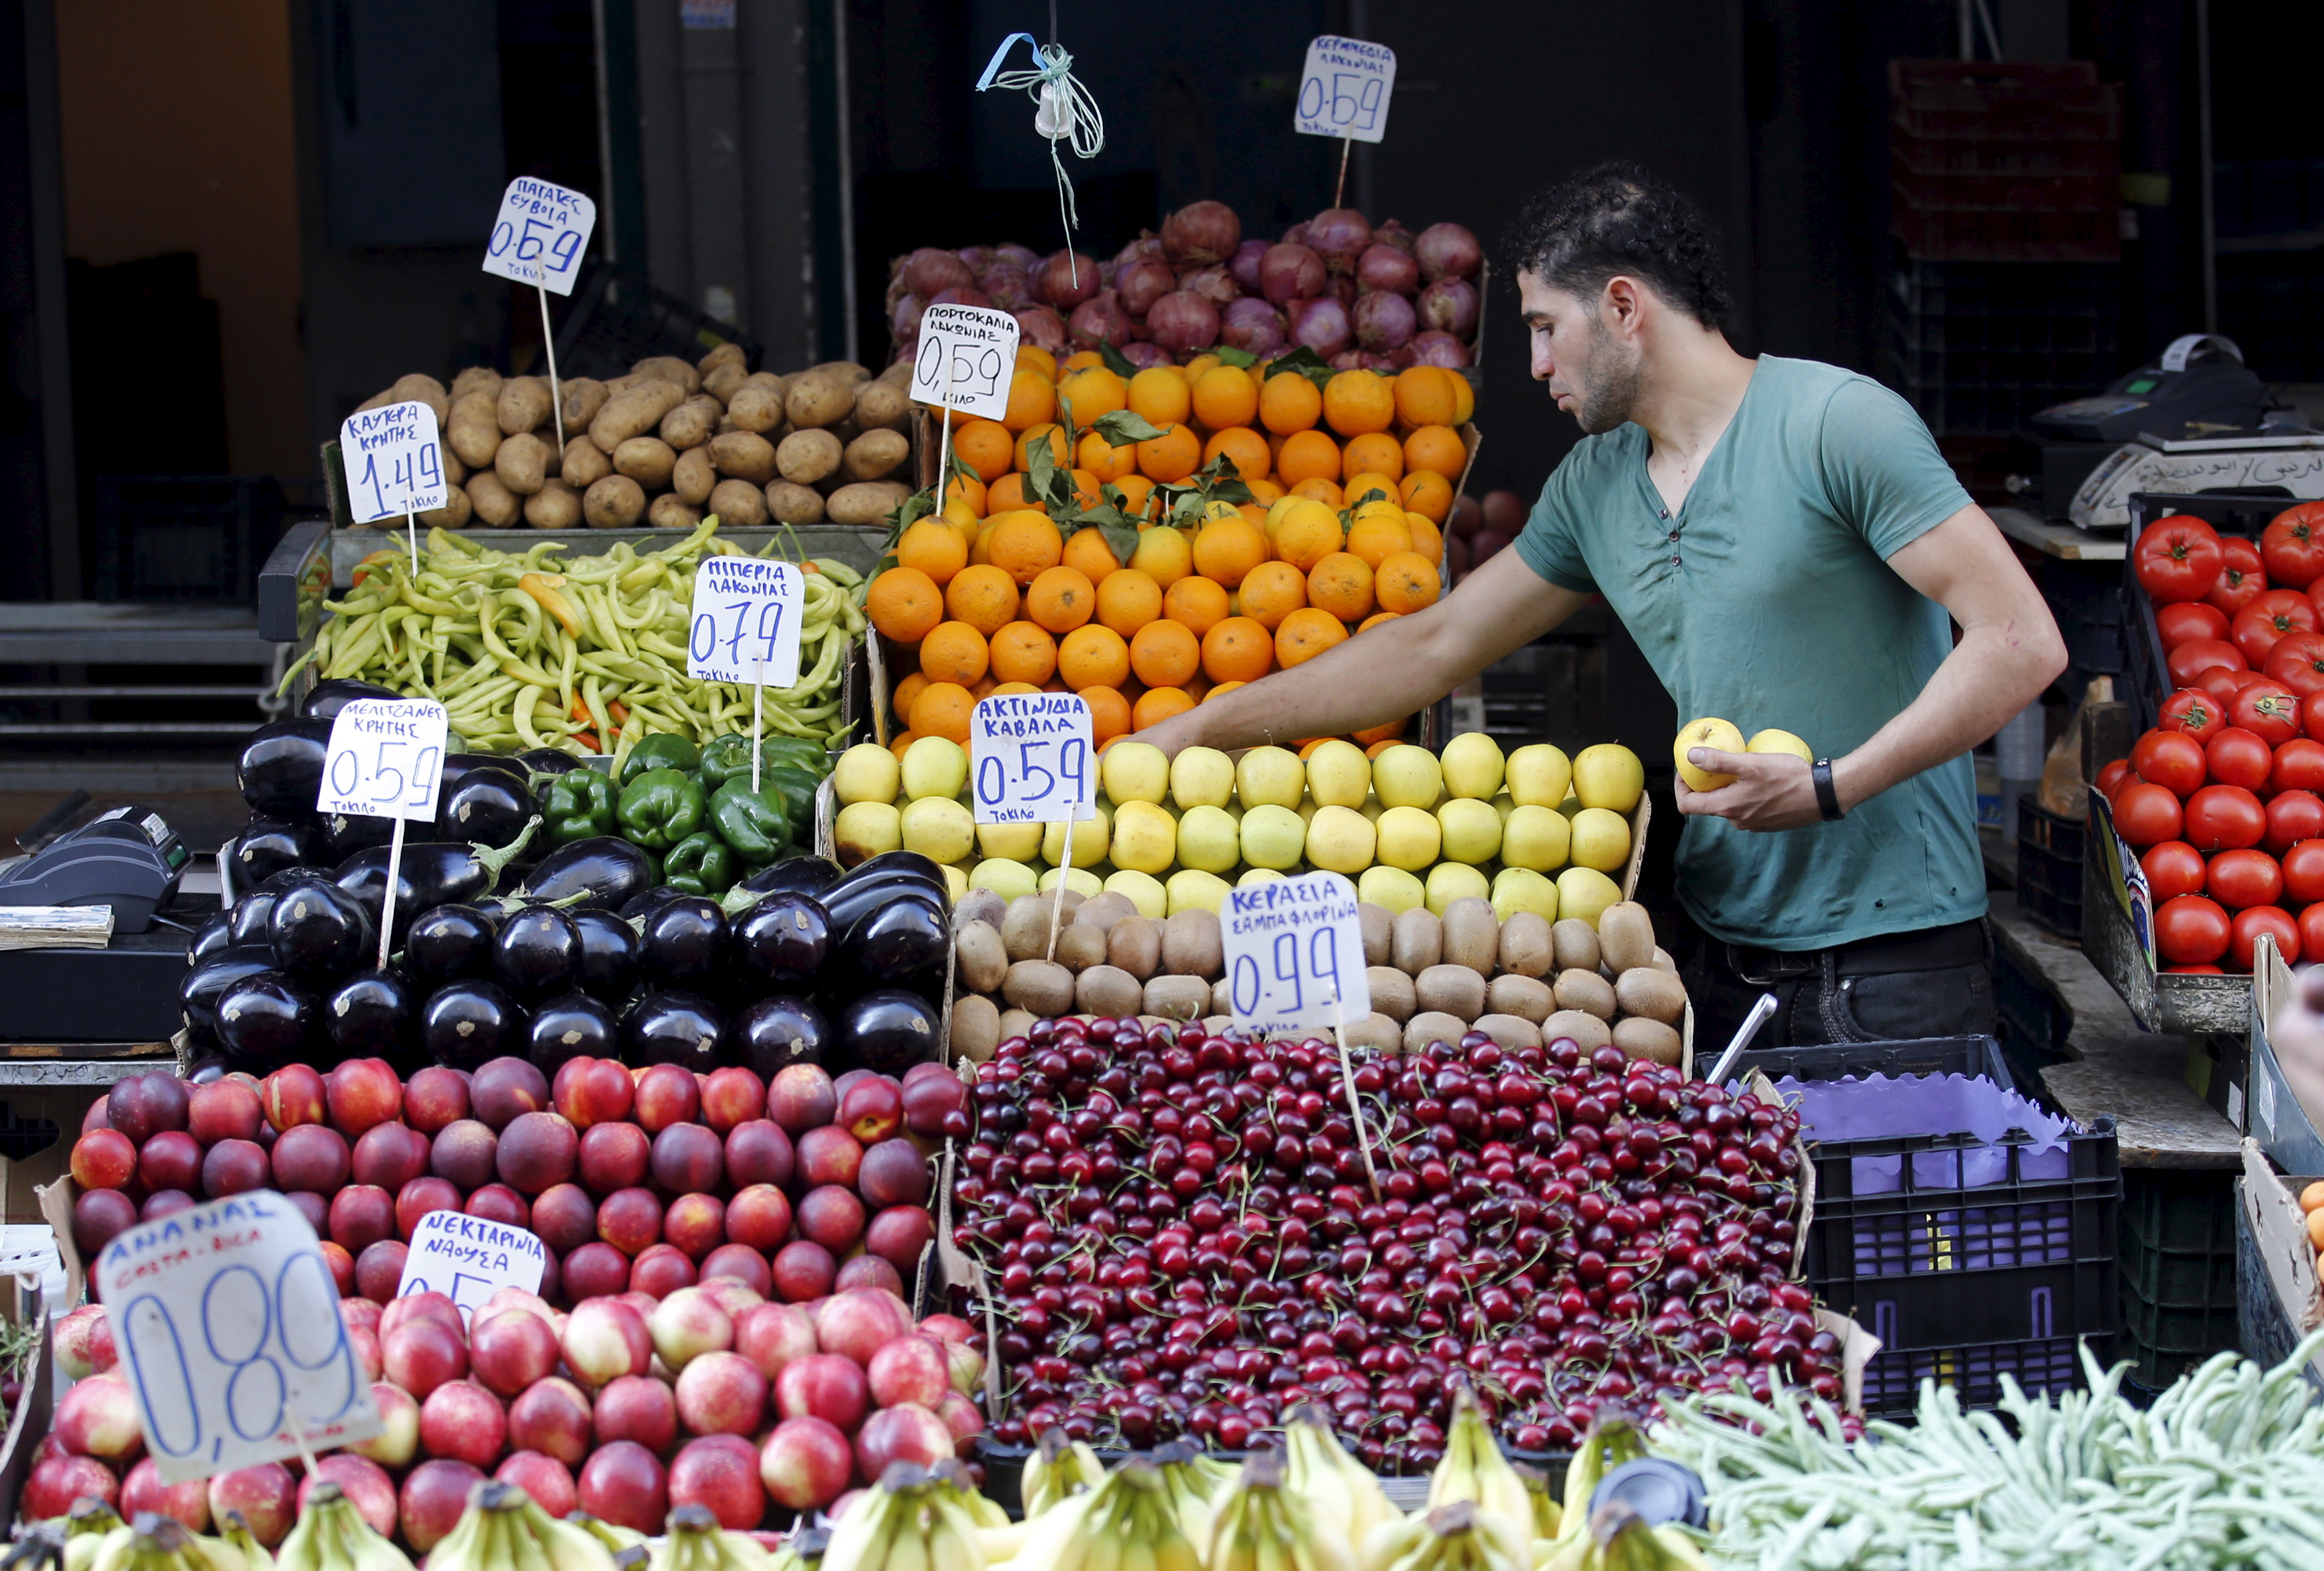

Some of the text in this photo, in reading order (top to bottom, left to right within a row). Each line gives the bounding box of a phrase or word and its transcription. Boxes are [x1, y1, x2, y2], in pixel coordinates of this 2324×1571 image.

[929, 307, 1015, 333] ΠΟΡΤΟΚΑΛΙΑ
[347, 404, 419, 439] ΚΑΥΤΕΡΑ
[359, 424, 418, 452] ΚΡΗΤΗΣ
[359, 442, 441, 521] 1.49
[345, 703, 442, 720] ΜΕΛΙΤΖΑΝΕΣ
[979, 696, 1084, 719] ΑΚΤΙΝΙΔΙΑ
[354, 717, 420, 739] ΚΡΗΤΗΣ
[984, 717, 1075, 738] ΚΑΒΑΛΑ
[331, 742, 440, 807] 0.59
[977, 738, 1086, 805] 0.59
[1231, 880, 1339, 914] ΚΕΡΑΣΙΑ
[1233, 926, 1342, 1017] 0.99
[426, 1213, 542, 1260] ΝΕΚΤΑΡΙΝΙΑ
[425, 1238, 509, 1272] ΝΑΟΥΣΑ
